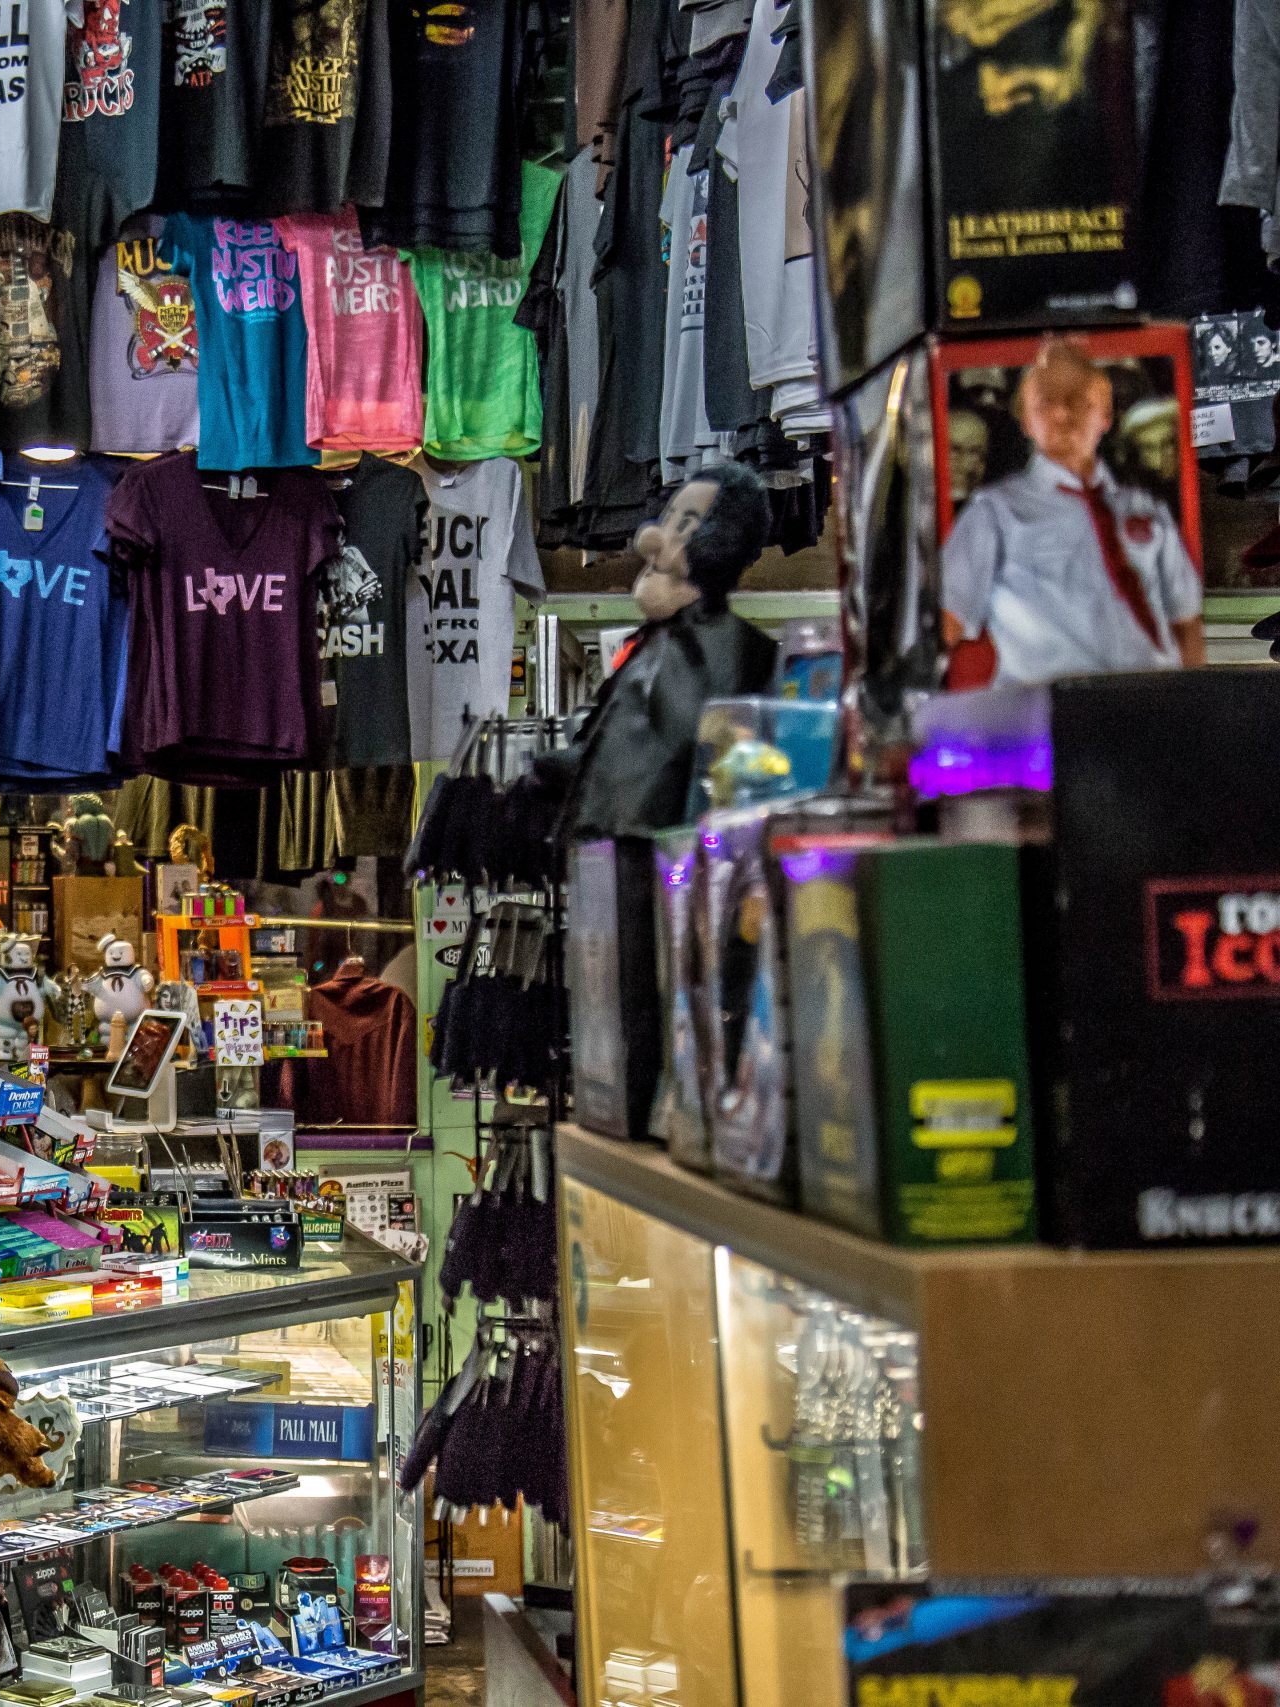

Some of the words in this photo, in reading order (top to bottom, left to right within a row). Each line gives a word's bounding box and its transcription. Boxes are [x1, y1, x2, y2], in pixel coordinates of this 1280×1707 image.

[290, 57, 342, 76] KEEP
[212, 247, 296, 282] AUSTIN
[326, 255, 399, 288] AUSTI
[216, 278, 296, 313] WEIRD
[220, 1011, 260, 1037] tips
[345, 1180, 380, 1189] Austin's
[380, 1179, 405, 1188] Pizza
[66, 1258, 88, 1268] Orbit
[250, 1252, 288, 1266] Mints
[279, 1418, 306, 1442] PALL
[308, 1419, 338, 1443] MALL
